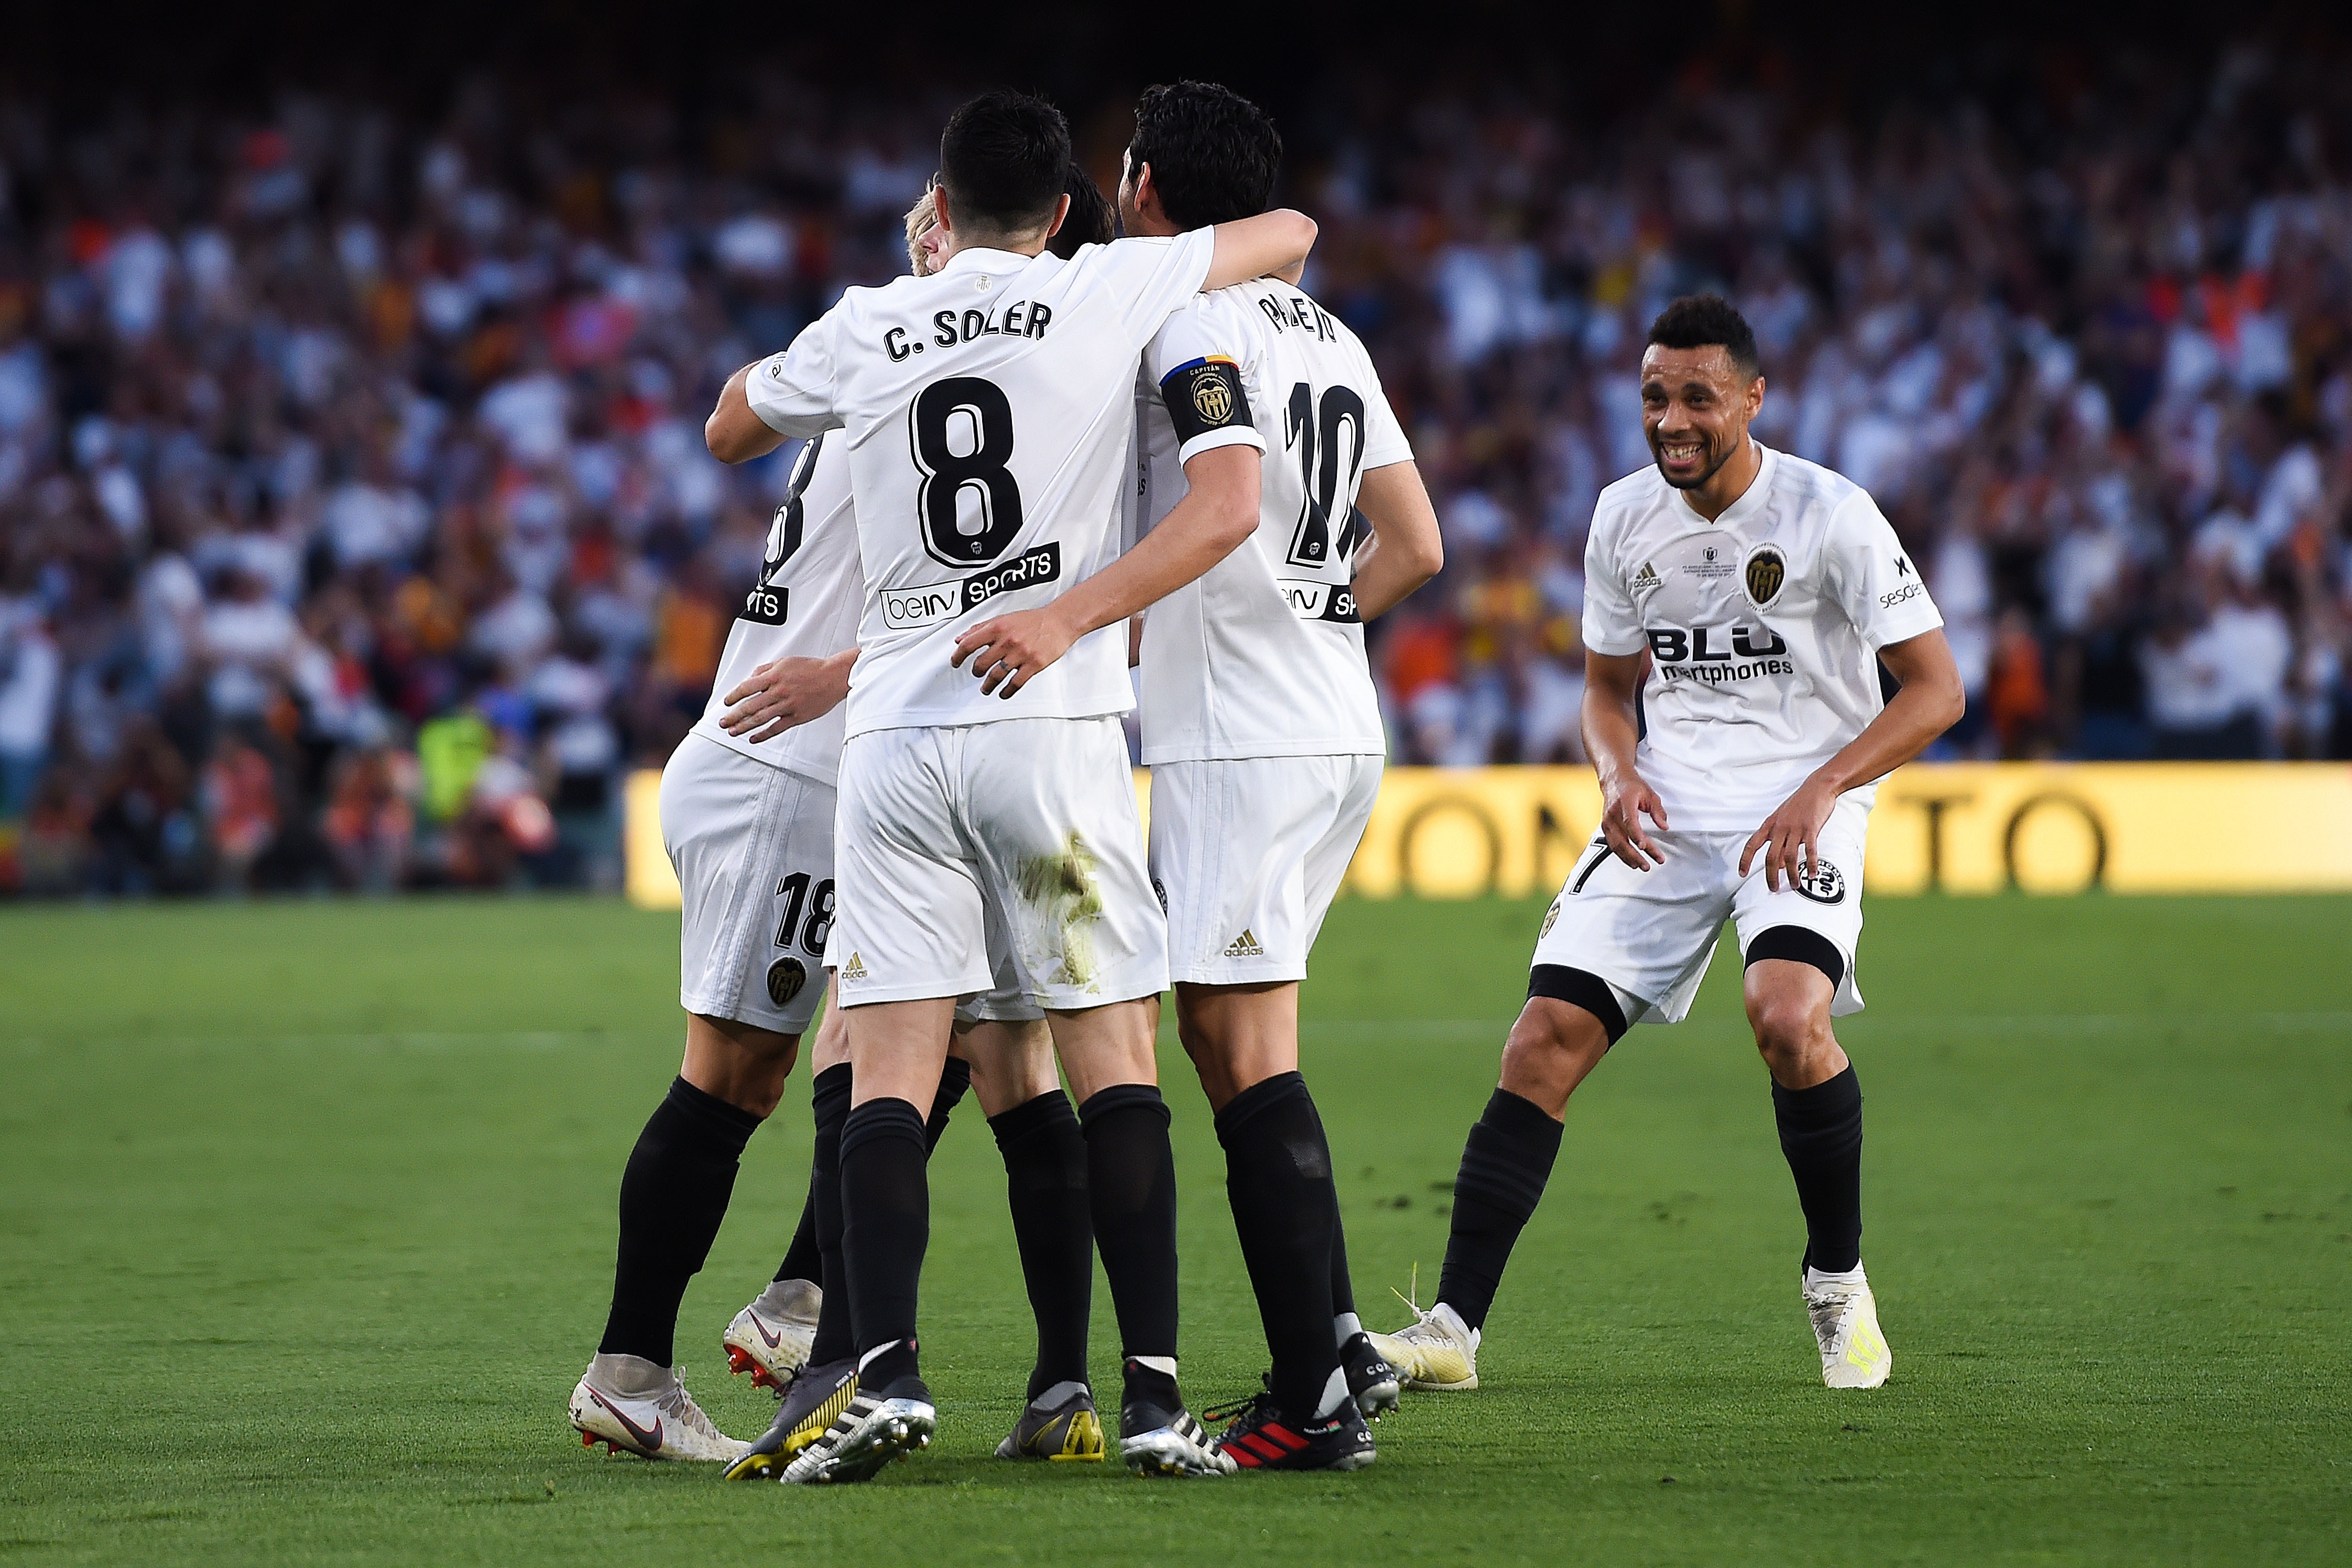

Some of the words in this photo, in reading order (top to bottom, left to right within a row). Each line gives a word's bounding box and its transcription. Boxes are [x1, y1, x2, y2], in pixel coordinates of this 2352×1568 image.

[884, 326, 924, 363] C.
[933, 300, 1052, 348] SOLER
[909, 376, 1023, 569] 8
[1284, 382, 1365, 569] 10
[1647, 627, 1787, 662] BLU
[774, 872, 836, 958] 18
[1224, 945, 1264, 957] adidas
